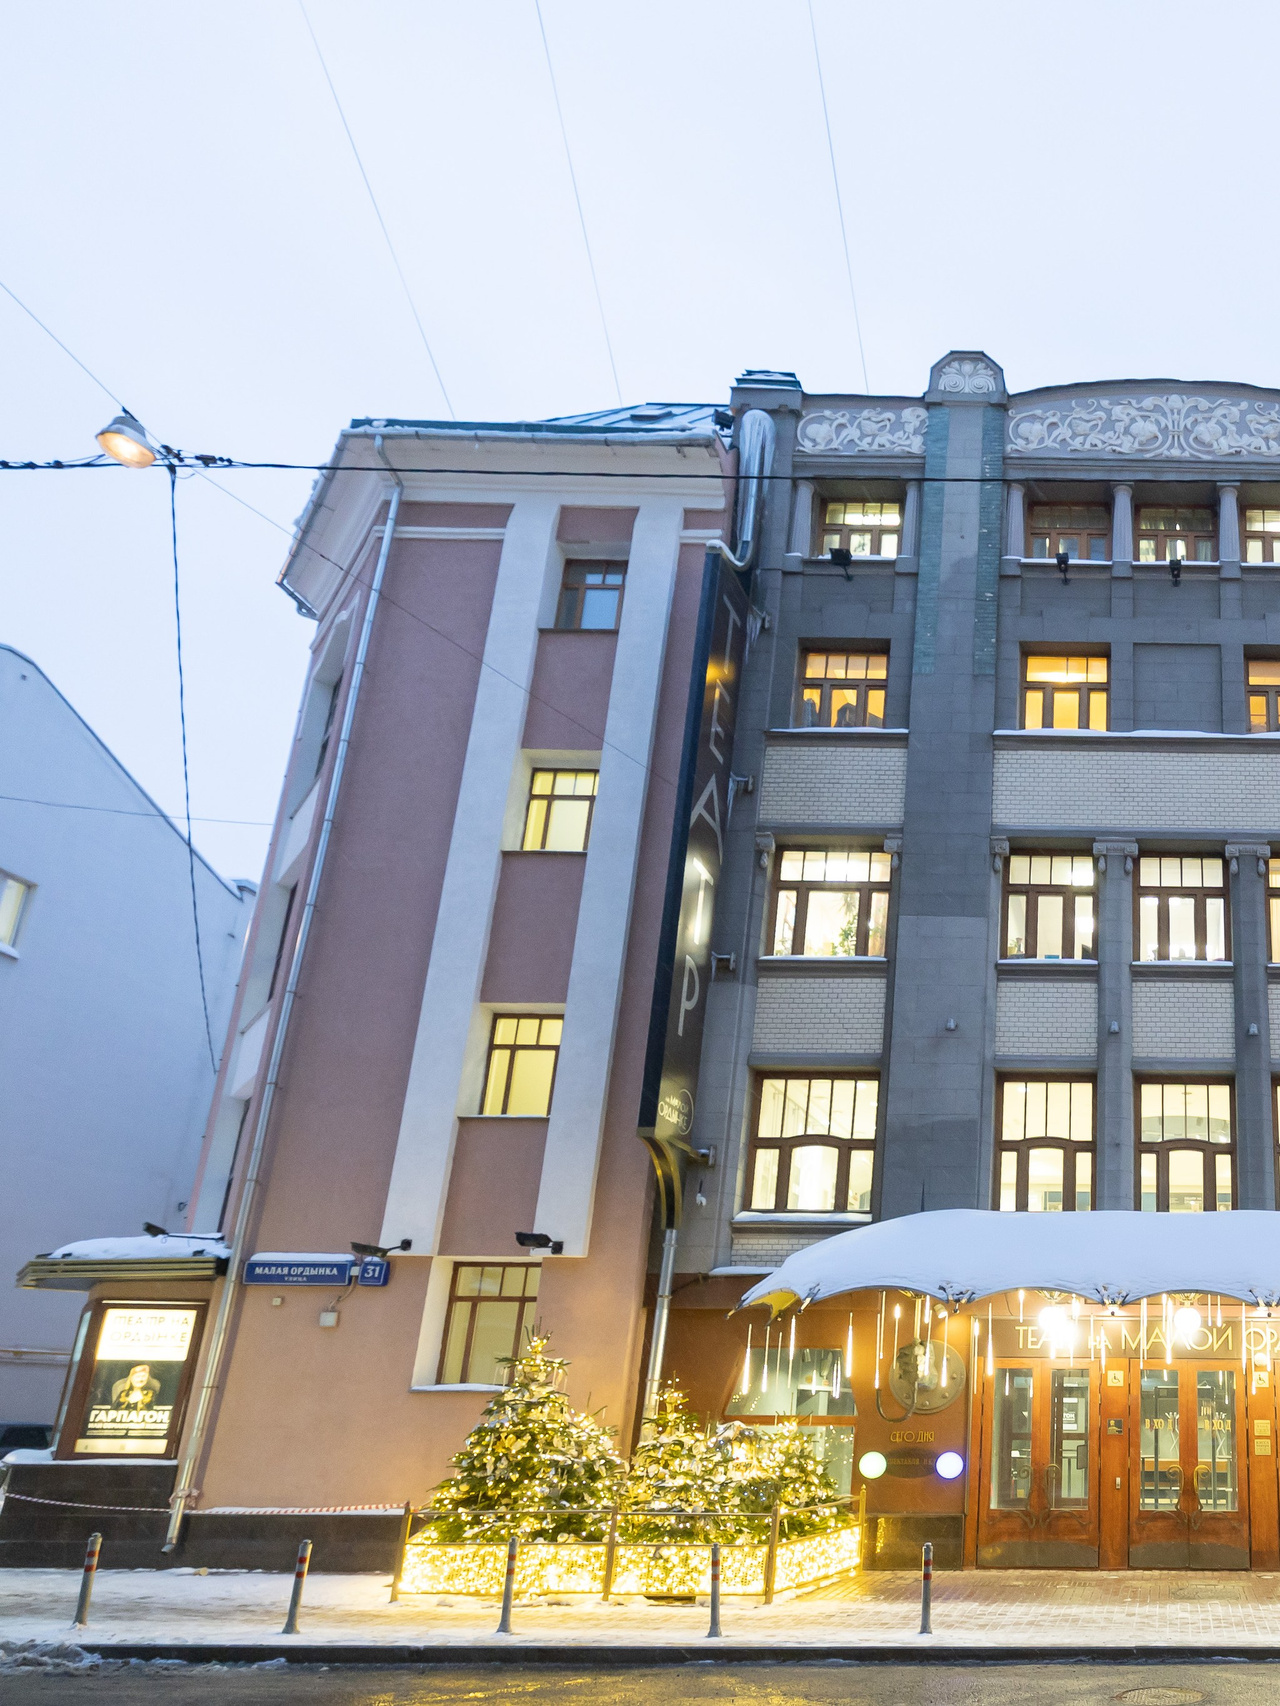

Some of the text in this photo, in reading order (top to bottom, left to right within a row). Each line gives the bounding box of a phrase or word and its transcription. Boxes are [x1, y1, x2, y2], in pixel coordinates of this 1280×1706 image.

[678, 593, 742, 1037] ТЕАТР
[254, 1266, 339, 1276] МАЛАЯ ОРДЫНКА
[363, 1265, 380, 1278] 31
[1145, 1418, 1173, 1429] ВХОД
[1204, 1419, 1231, 1430] ВХОД
[890, 1430, 935, 1443] СЕГОДНЯ
